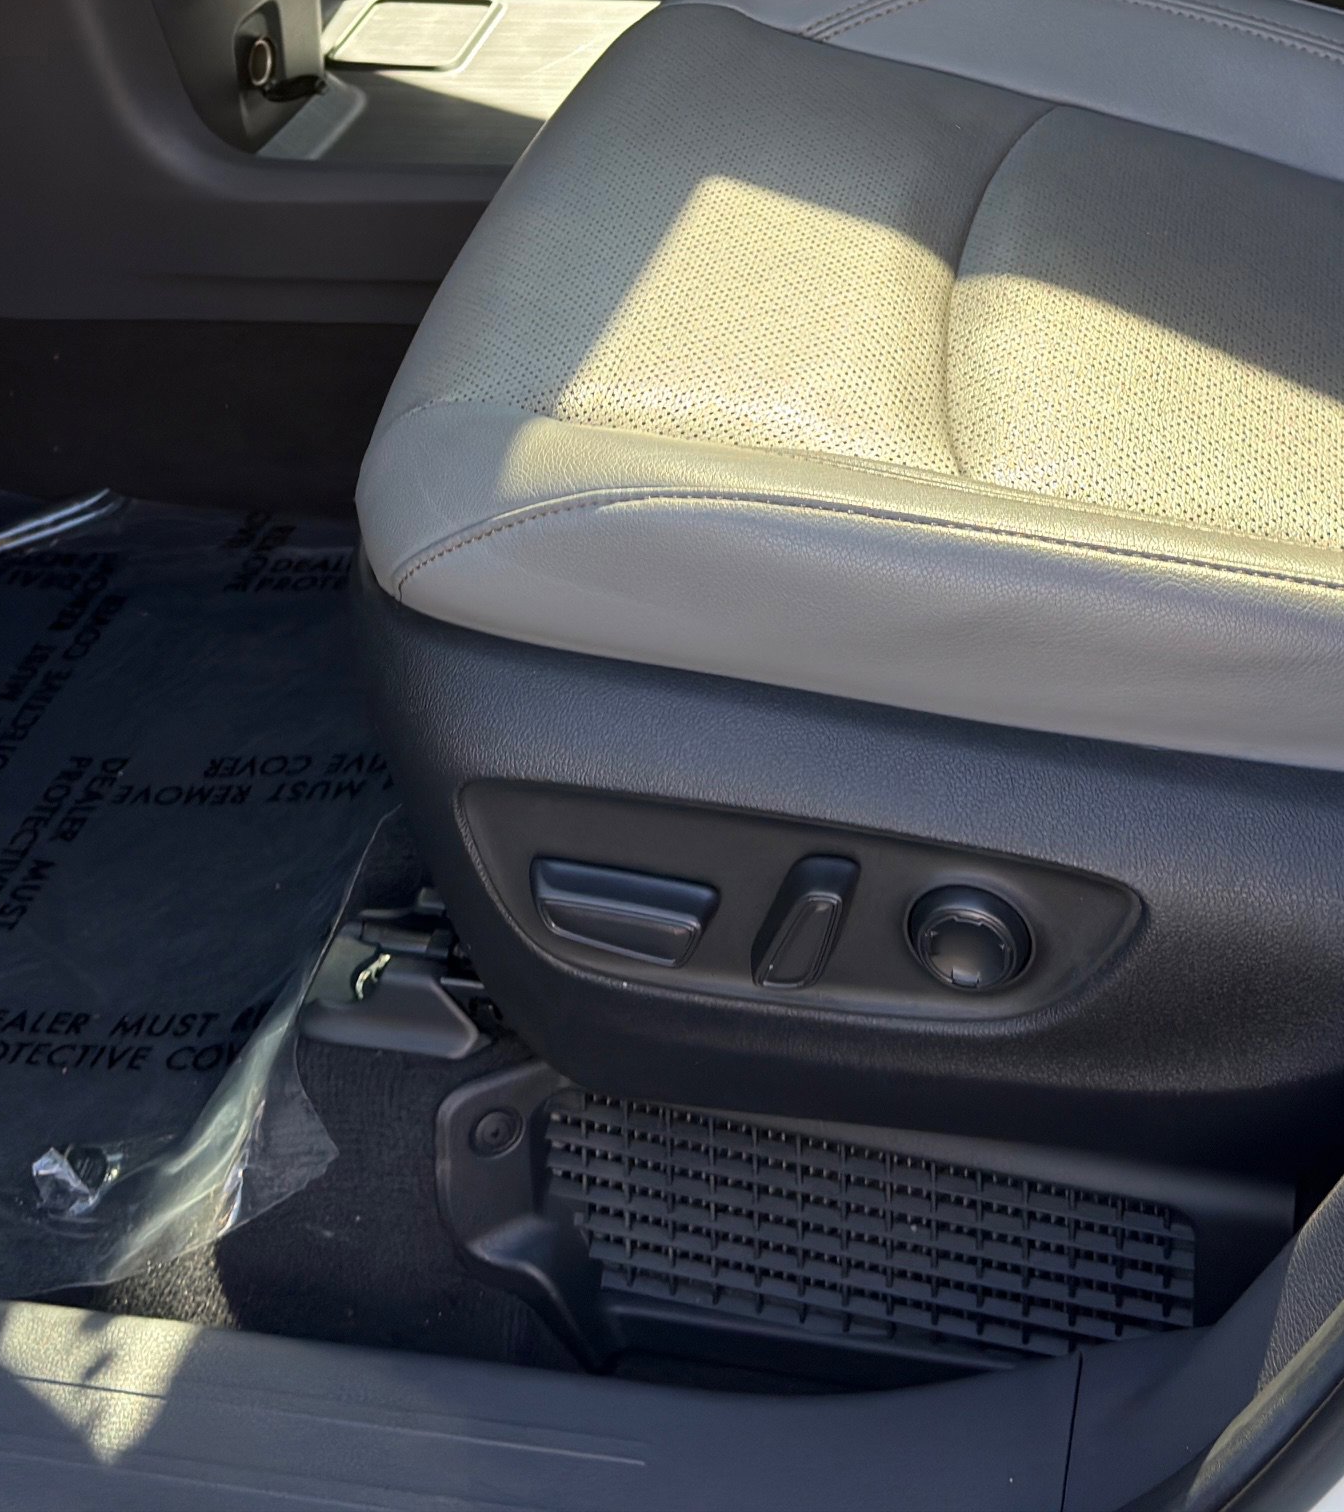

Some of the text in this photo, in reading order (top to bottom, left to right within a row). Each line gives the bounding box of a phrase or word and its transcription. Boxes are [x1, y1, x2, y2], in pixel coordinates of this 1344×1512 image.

[203, 754, 313, 779] COVER
[50, 755, 129, 844] DEALER
[112, 779, 369, 808] MUST REMOVE
[1, 859, 56, 932] MUST
[111, 1011, 220, 1038] MUST
[165, 1045, 251, 1074] COV
